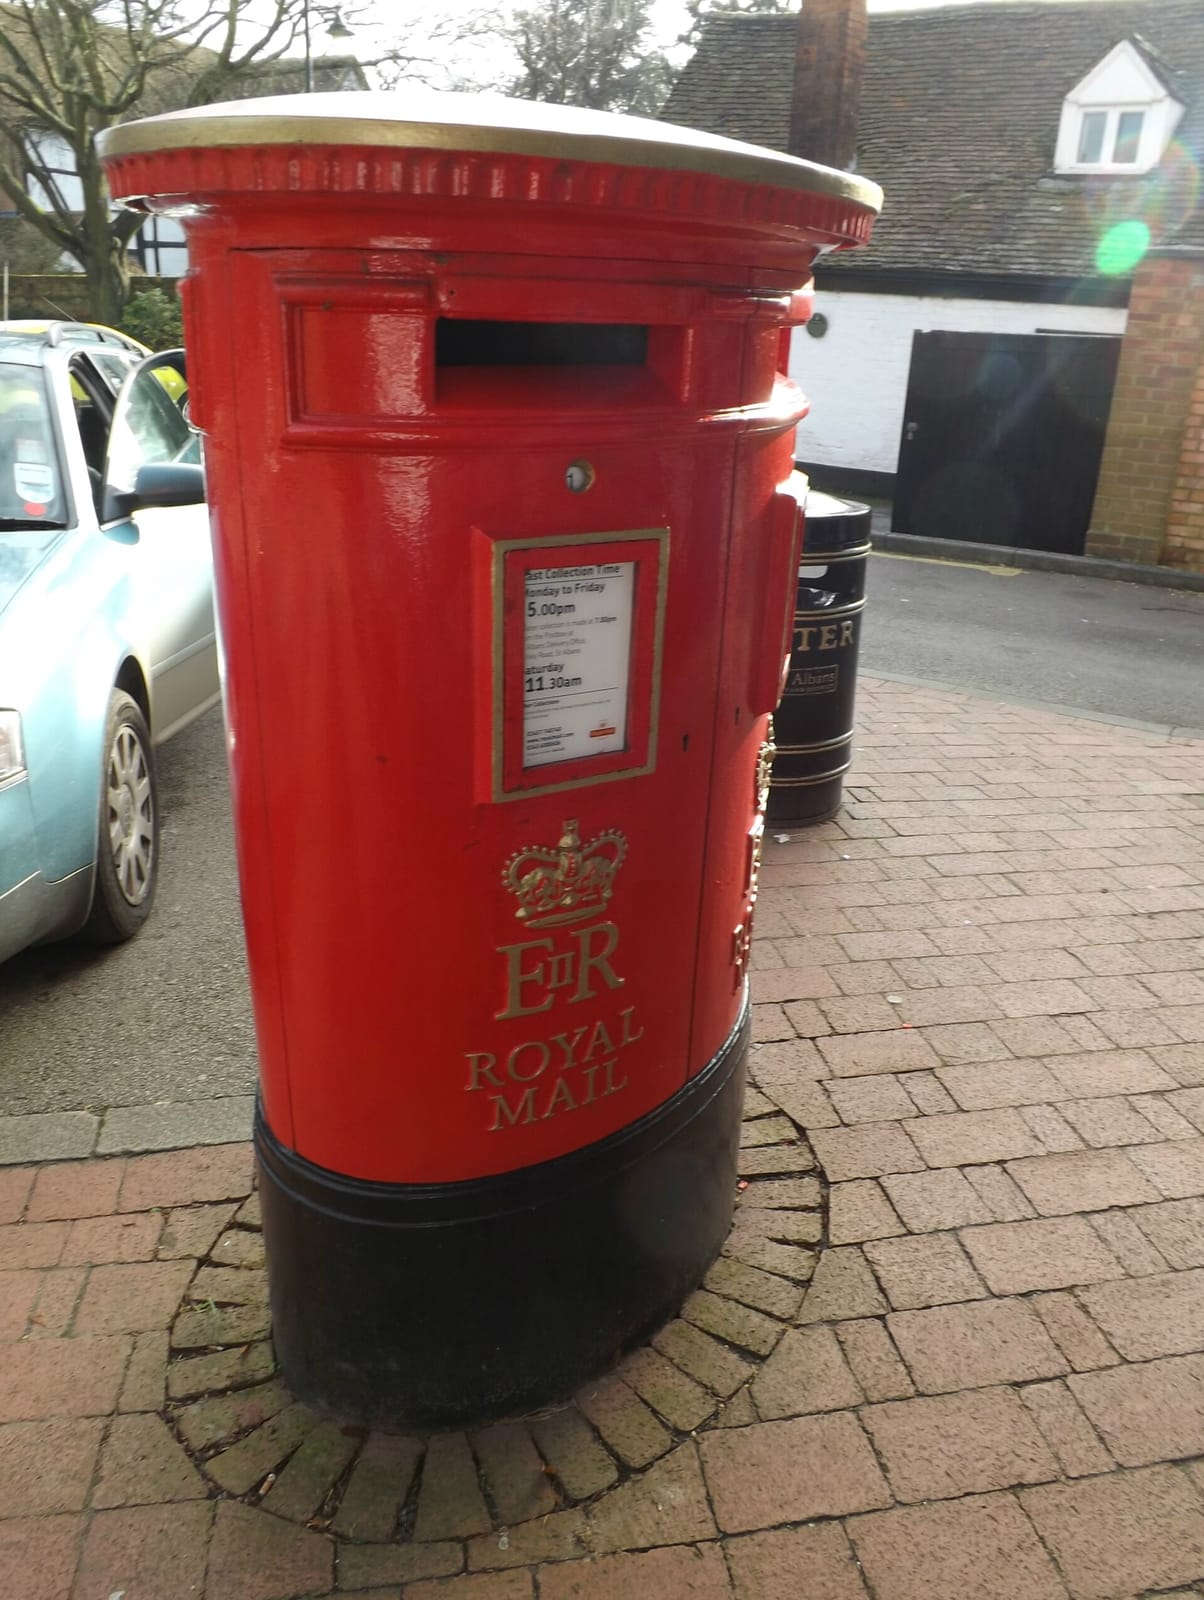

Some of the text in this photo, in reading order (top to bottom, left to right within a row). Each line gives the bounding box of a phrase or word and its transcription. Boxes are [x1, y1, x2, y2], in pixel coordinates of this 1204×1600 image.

[526, 571, 543, 580] ast
[545, 567, 594, 579] Collection
[562, 586, 572, 594] to
[575, 582, 606, 593] Friday
[527, 601, 576, 617] 5.00pm
[793, 620, 853, 651] TER
[525, 664, 564, 675] aturday
[526, 676, 582, 692] 11.30am
[464, 1005, 645, 1091] ROYAL
[488, 1057, 628, 1132] MAIL
